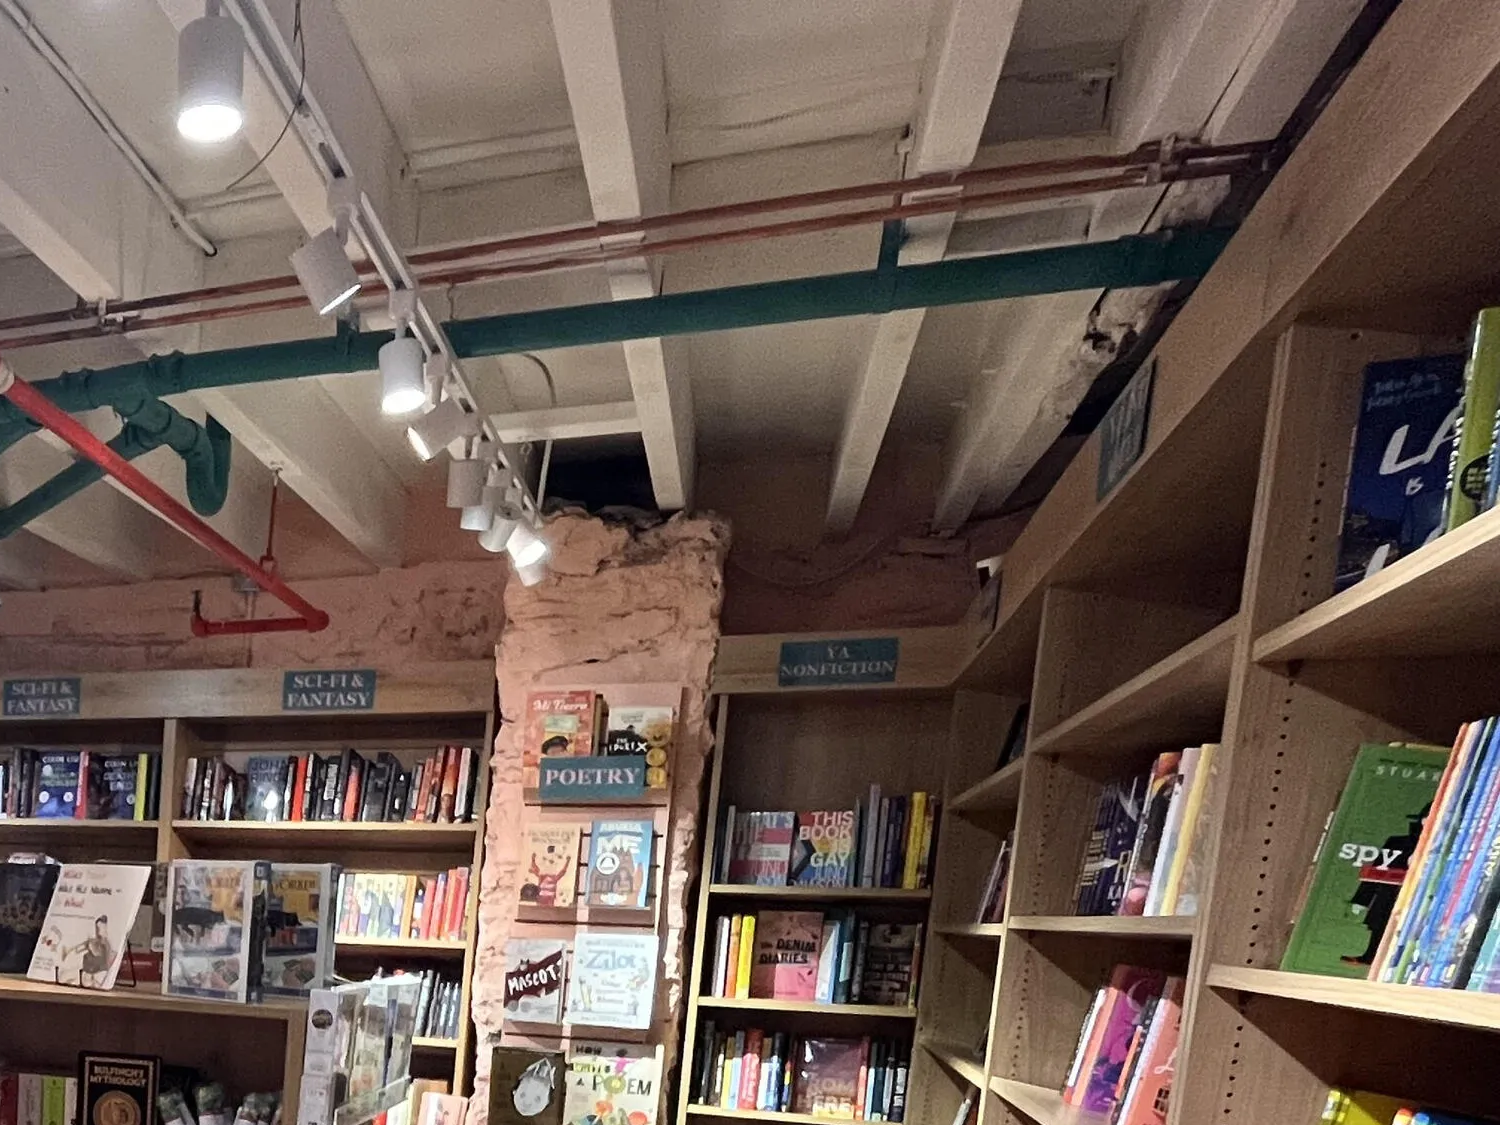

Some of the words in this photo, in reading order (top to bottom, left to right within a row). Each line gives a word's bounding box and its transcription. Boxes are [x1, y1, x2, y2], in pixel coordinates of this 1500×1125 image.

[827, 645, 850, 659] YA
[782, 660, 895, 677] NONFICTION
[12, 683, 58, 695] SCI-FI
[60, 683, 73, 695] &
[293, 674, 347, 689] SCI-FI
[351, 675, 364, 688] &
[7, 698, 77, 713] FANTASY
[288, 693, 368, 708] FANTASY
[636, 742, 648, 752] X
[545, 767, 640, 786] POETRY
[811, 811, 854, 827] THIS
[799, 825, 852, 841] BOOK
[810, 852, 849, 867] GAY
[1339, 840, 1402, 869] spy
[776, 938, 817, 952] DENIM
[759, 952, 808, 964] DIARIES
[508, 968, 557, 996] MASCOT
[575, 1045, 602, 1054] HOW
[89, 1074, 148, 1088] MYTHOLOGY
[592, 1075, 653, 1096] POEM
